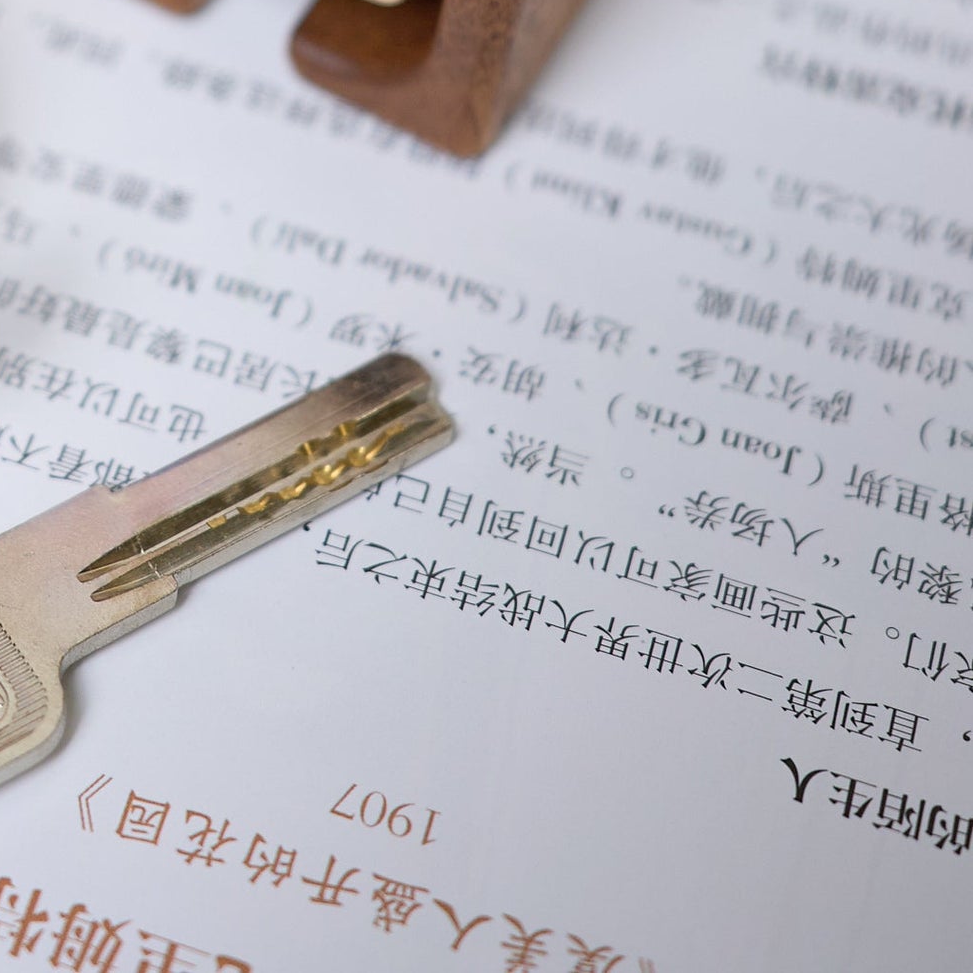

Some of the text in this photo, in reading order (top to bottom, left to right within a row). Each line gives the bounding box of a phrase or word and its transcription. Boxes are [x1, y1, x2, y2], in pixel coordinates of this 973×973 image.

[329, 784, 440, 845] 1907
[780, 757, 973, 856] 的陌生人
